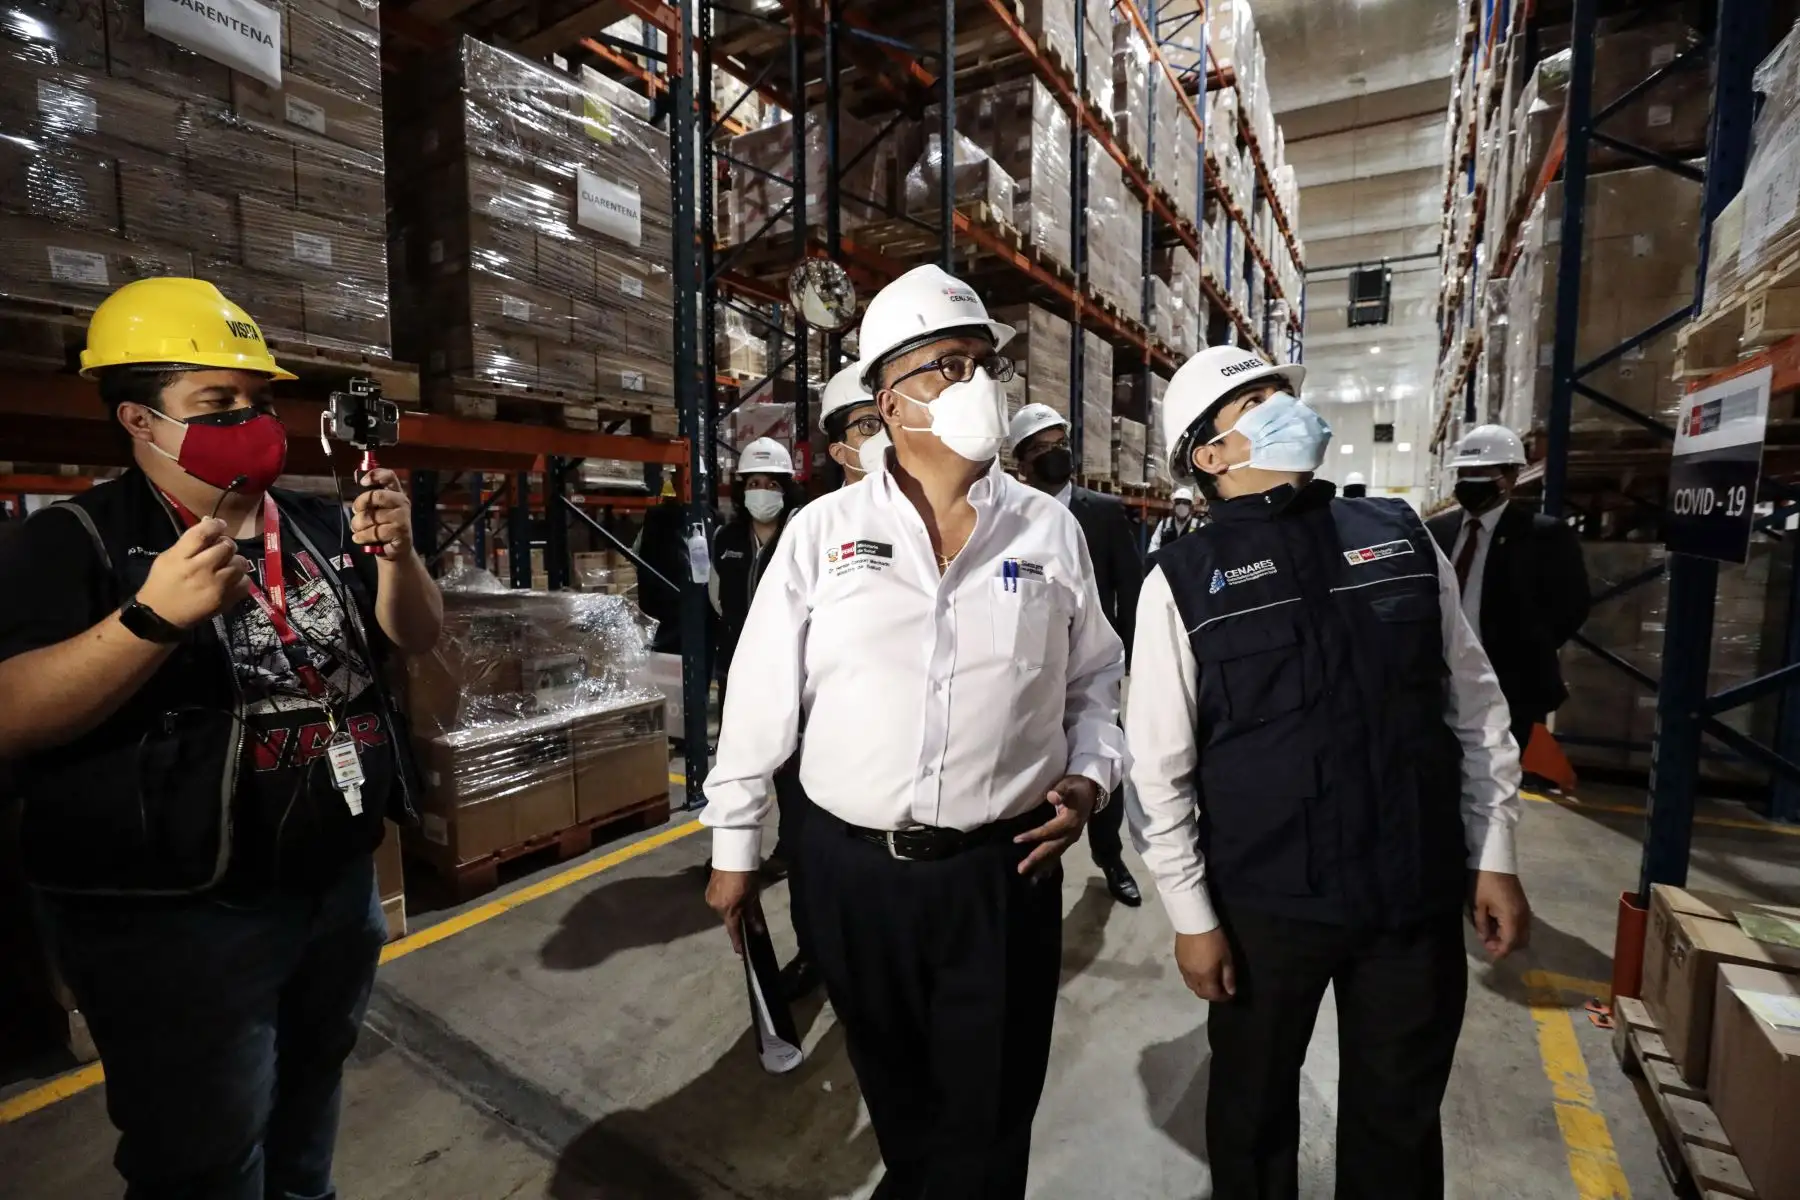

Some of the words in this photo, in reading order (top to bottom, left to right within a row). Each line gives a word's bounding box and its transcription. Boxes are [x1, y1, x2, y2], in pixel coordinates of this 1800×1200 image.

[171, 0, 275, 49] ARENTENA
[581, 190, 639, 220] CUARENTENA
[225, 319, 261, 343] VISITA
[1220, 358, 1264, 377] CENARES
[1674, 487, 1715, 515] COVID
[1725, 485, 1747, 517] 19
[1224, 559, 1274, 579] CENARES
